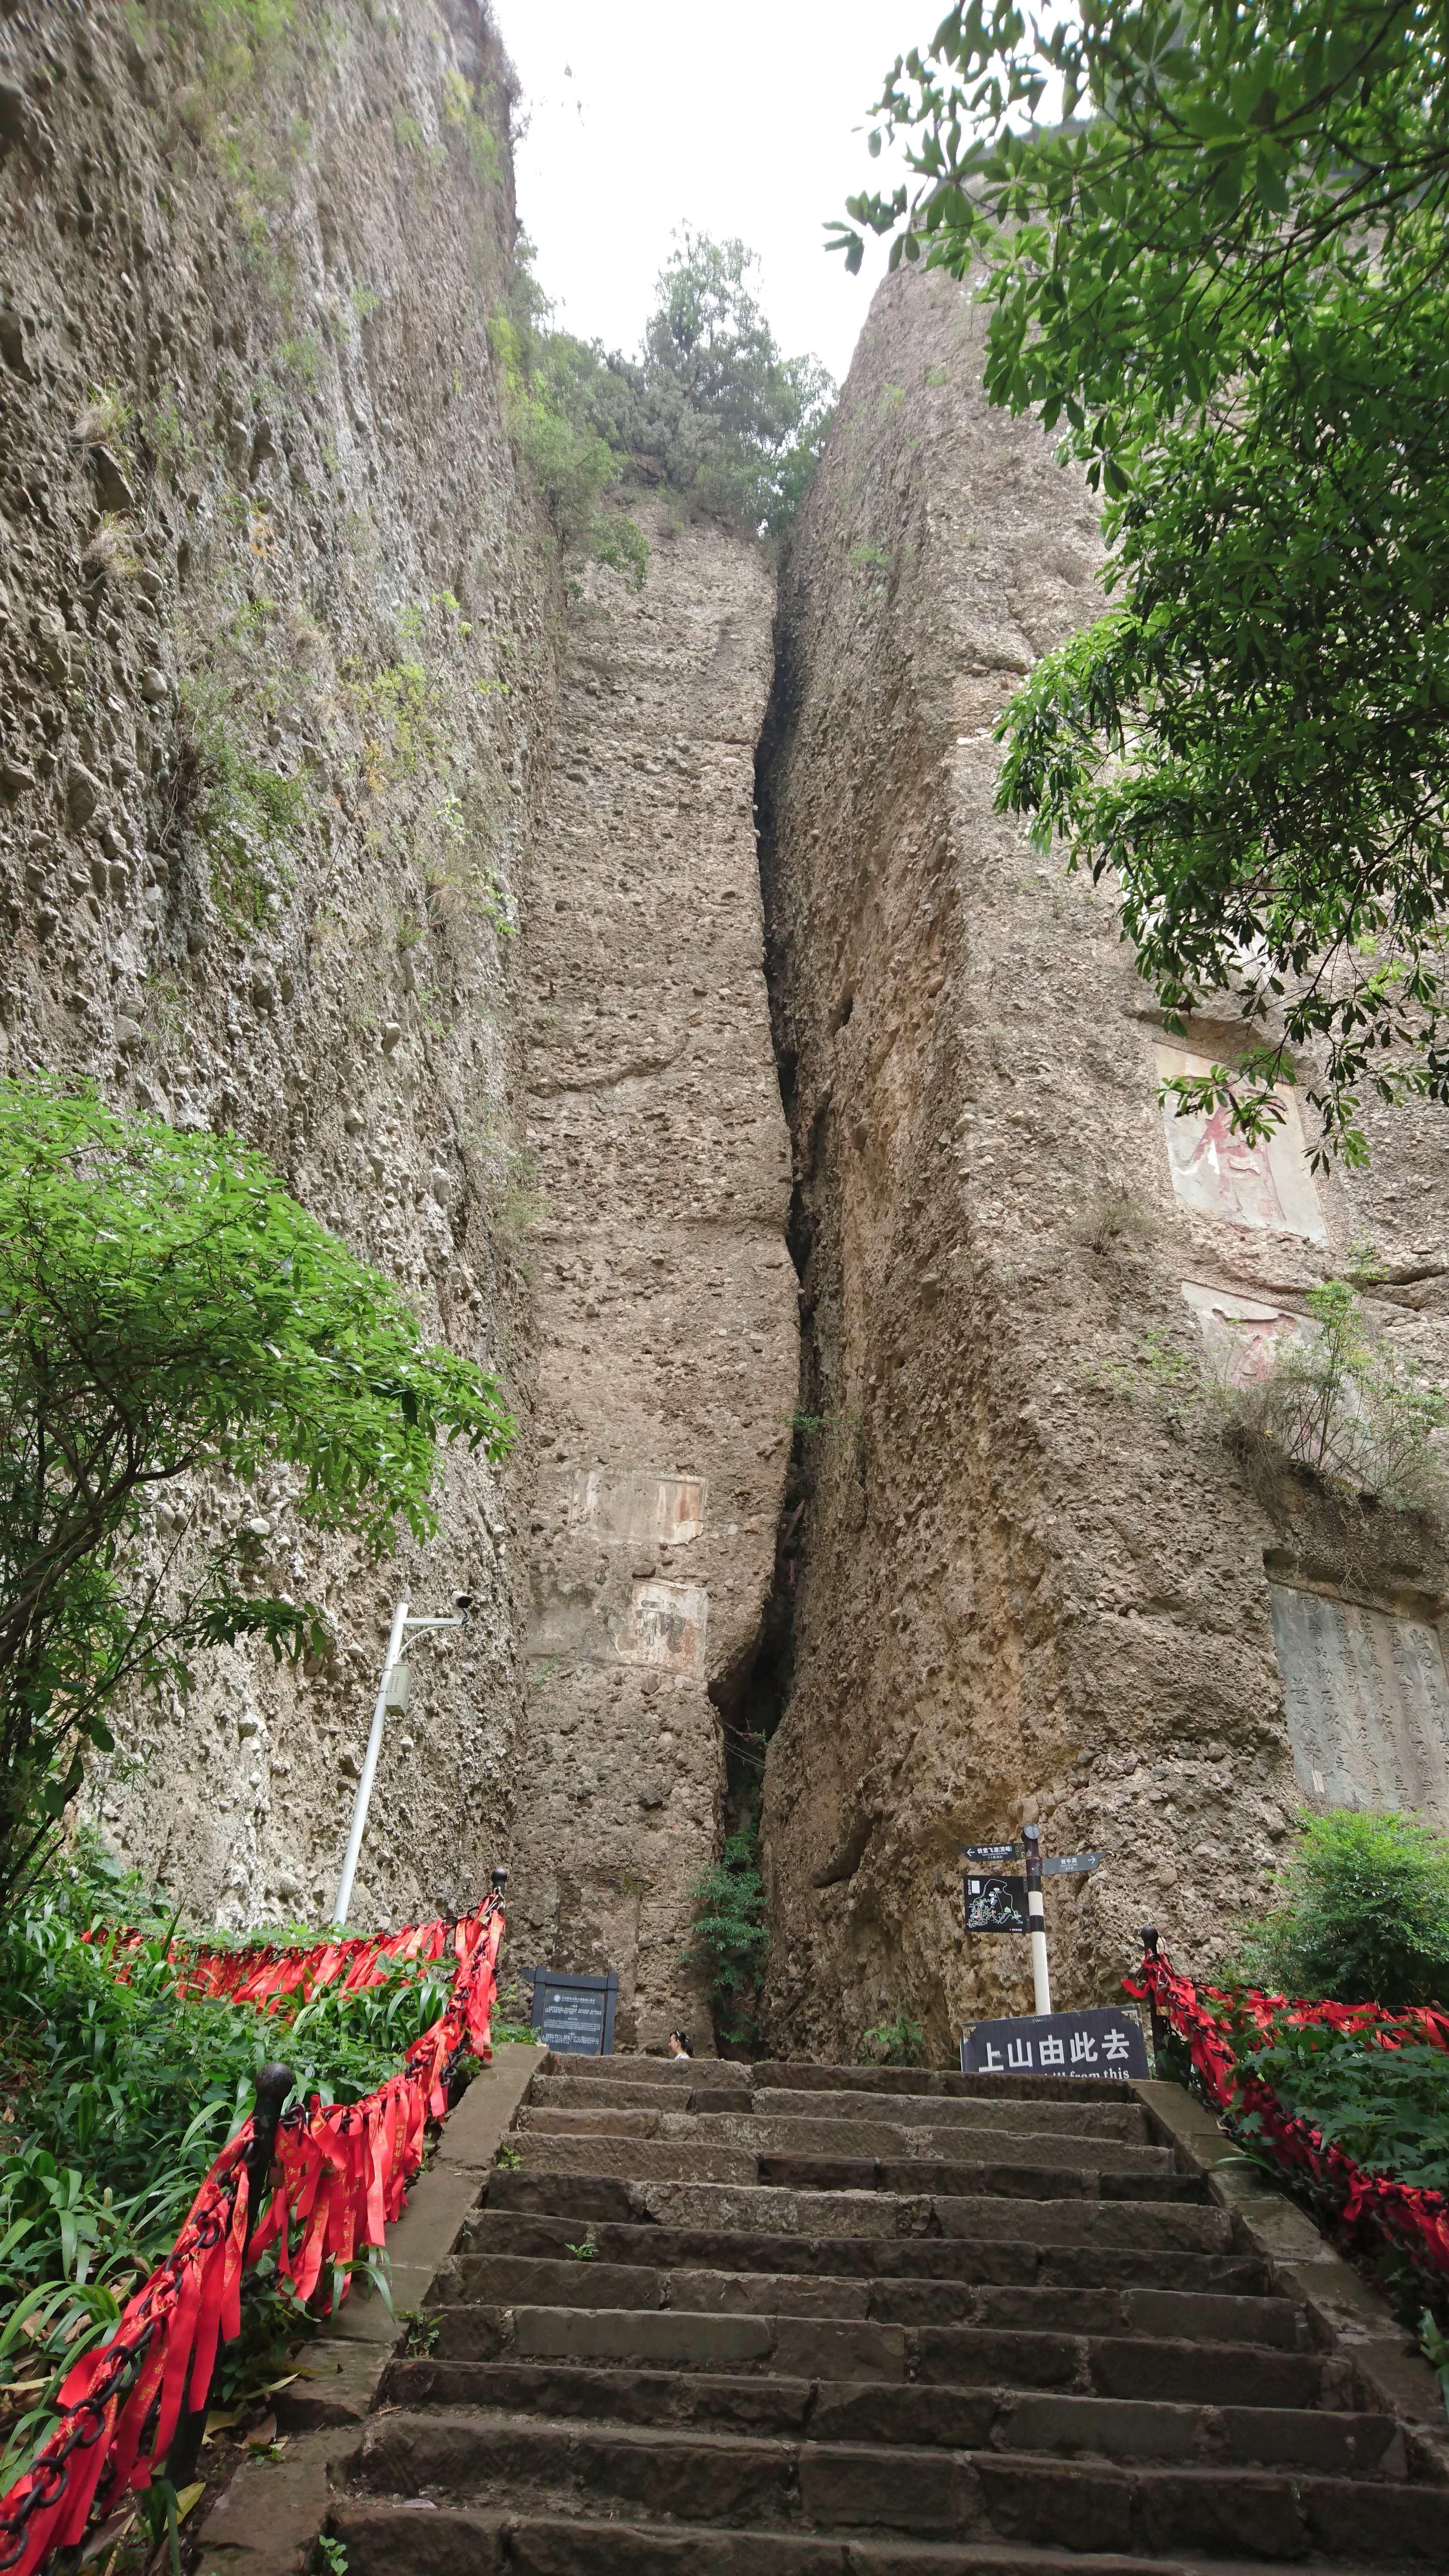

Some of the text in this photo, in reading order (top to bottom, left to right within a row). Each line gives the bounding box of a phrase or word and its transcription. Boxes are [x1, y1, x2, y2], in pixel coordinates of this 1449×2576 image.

[978, 2028, 1130, 2073] 上山由此去
[1103, 2067, 1130, 2079] this
